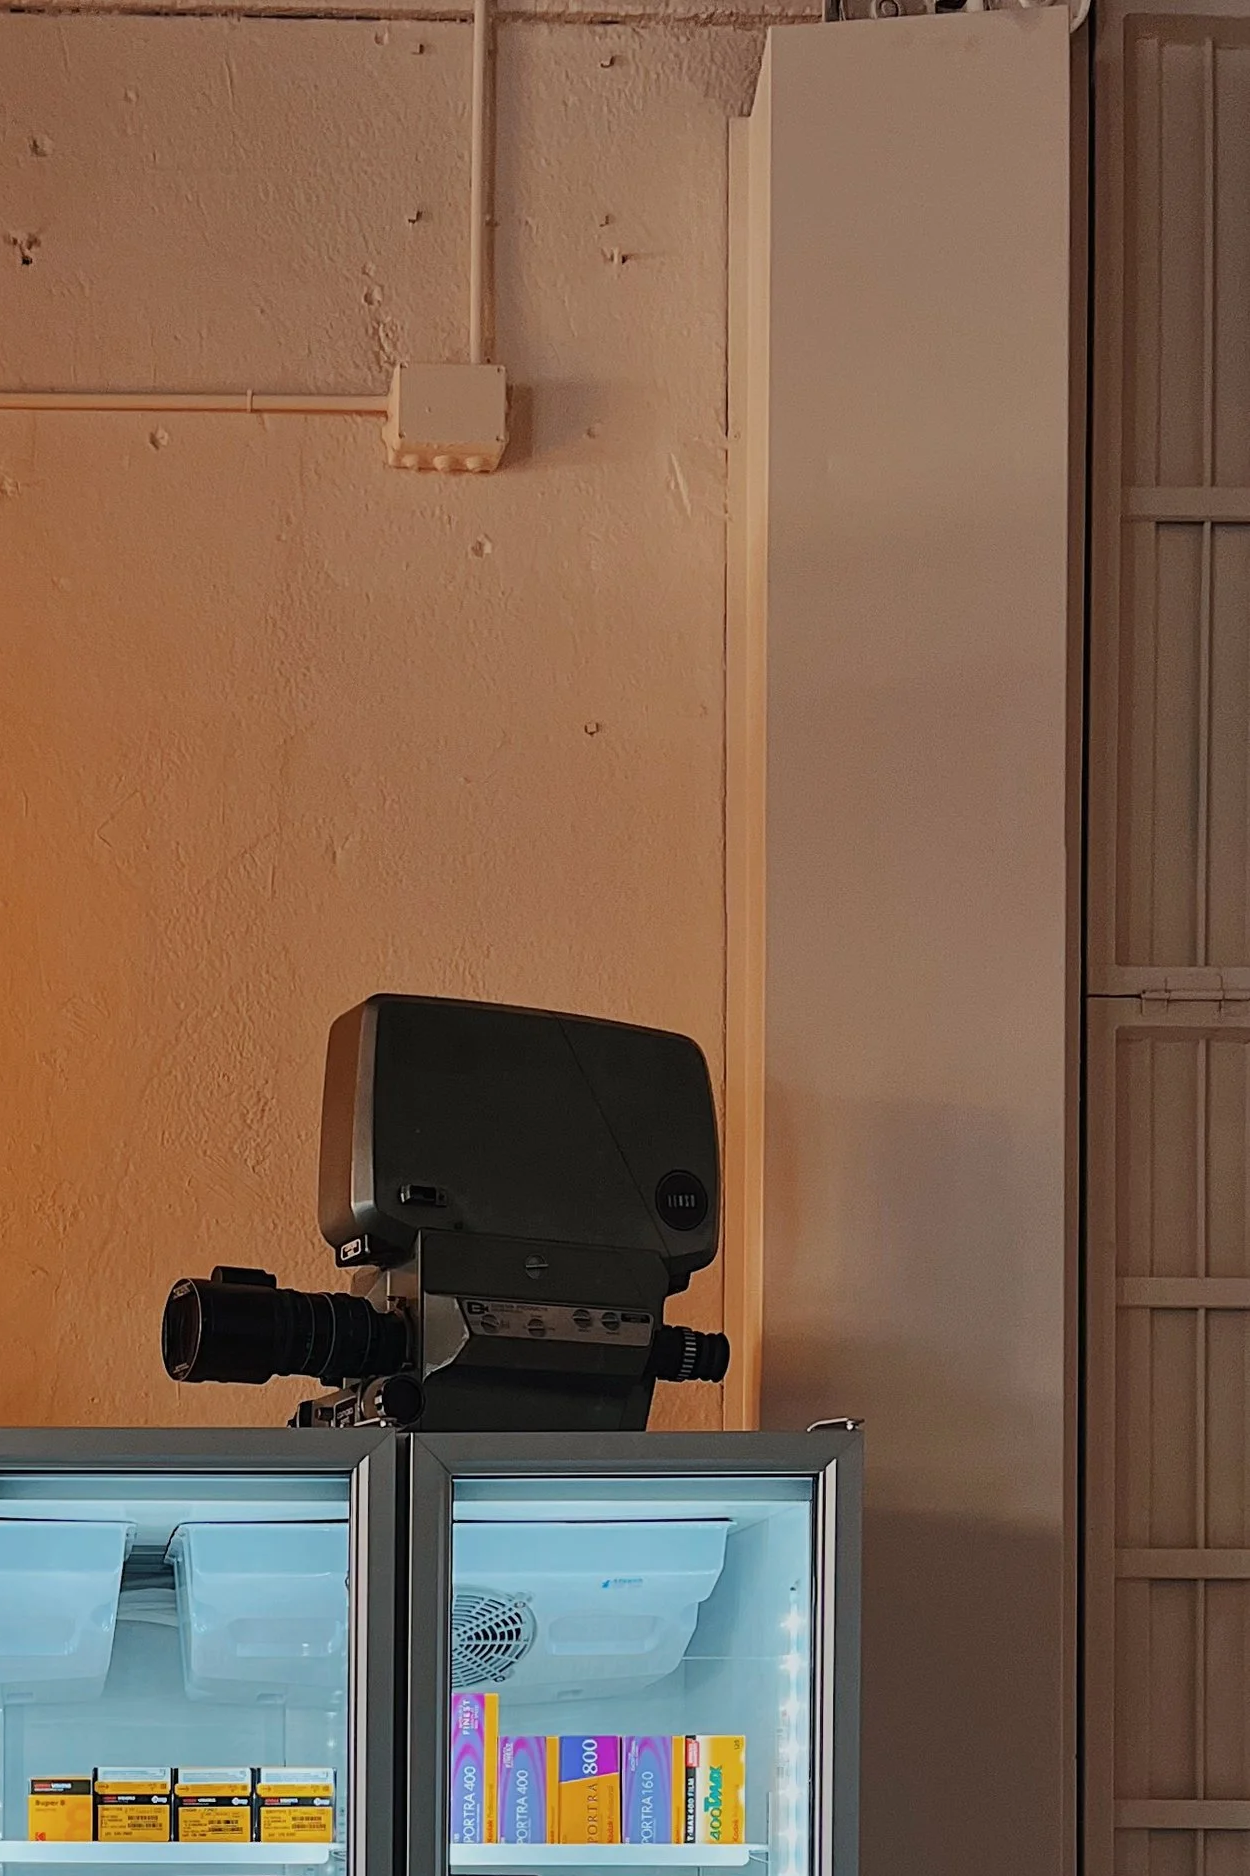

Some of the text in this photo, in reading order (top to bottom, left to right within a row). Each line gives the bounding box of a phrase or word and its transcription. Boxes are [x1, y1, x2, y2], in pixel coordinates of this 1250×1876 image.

[462, 1699, 471, 1736] FINEST
[462, 1766, 476, 1844] PORTRA 400
[516, 1769, 529, 1844] PORTRA 400
[582, 1738, 599, 1844] PORTRA 800
[641, 1770, 654, 1844] PORTRA 160
[686, 1777, 695, 1798] FILM
[686, 1798, 695, 1814] 400
